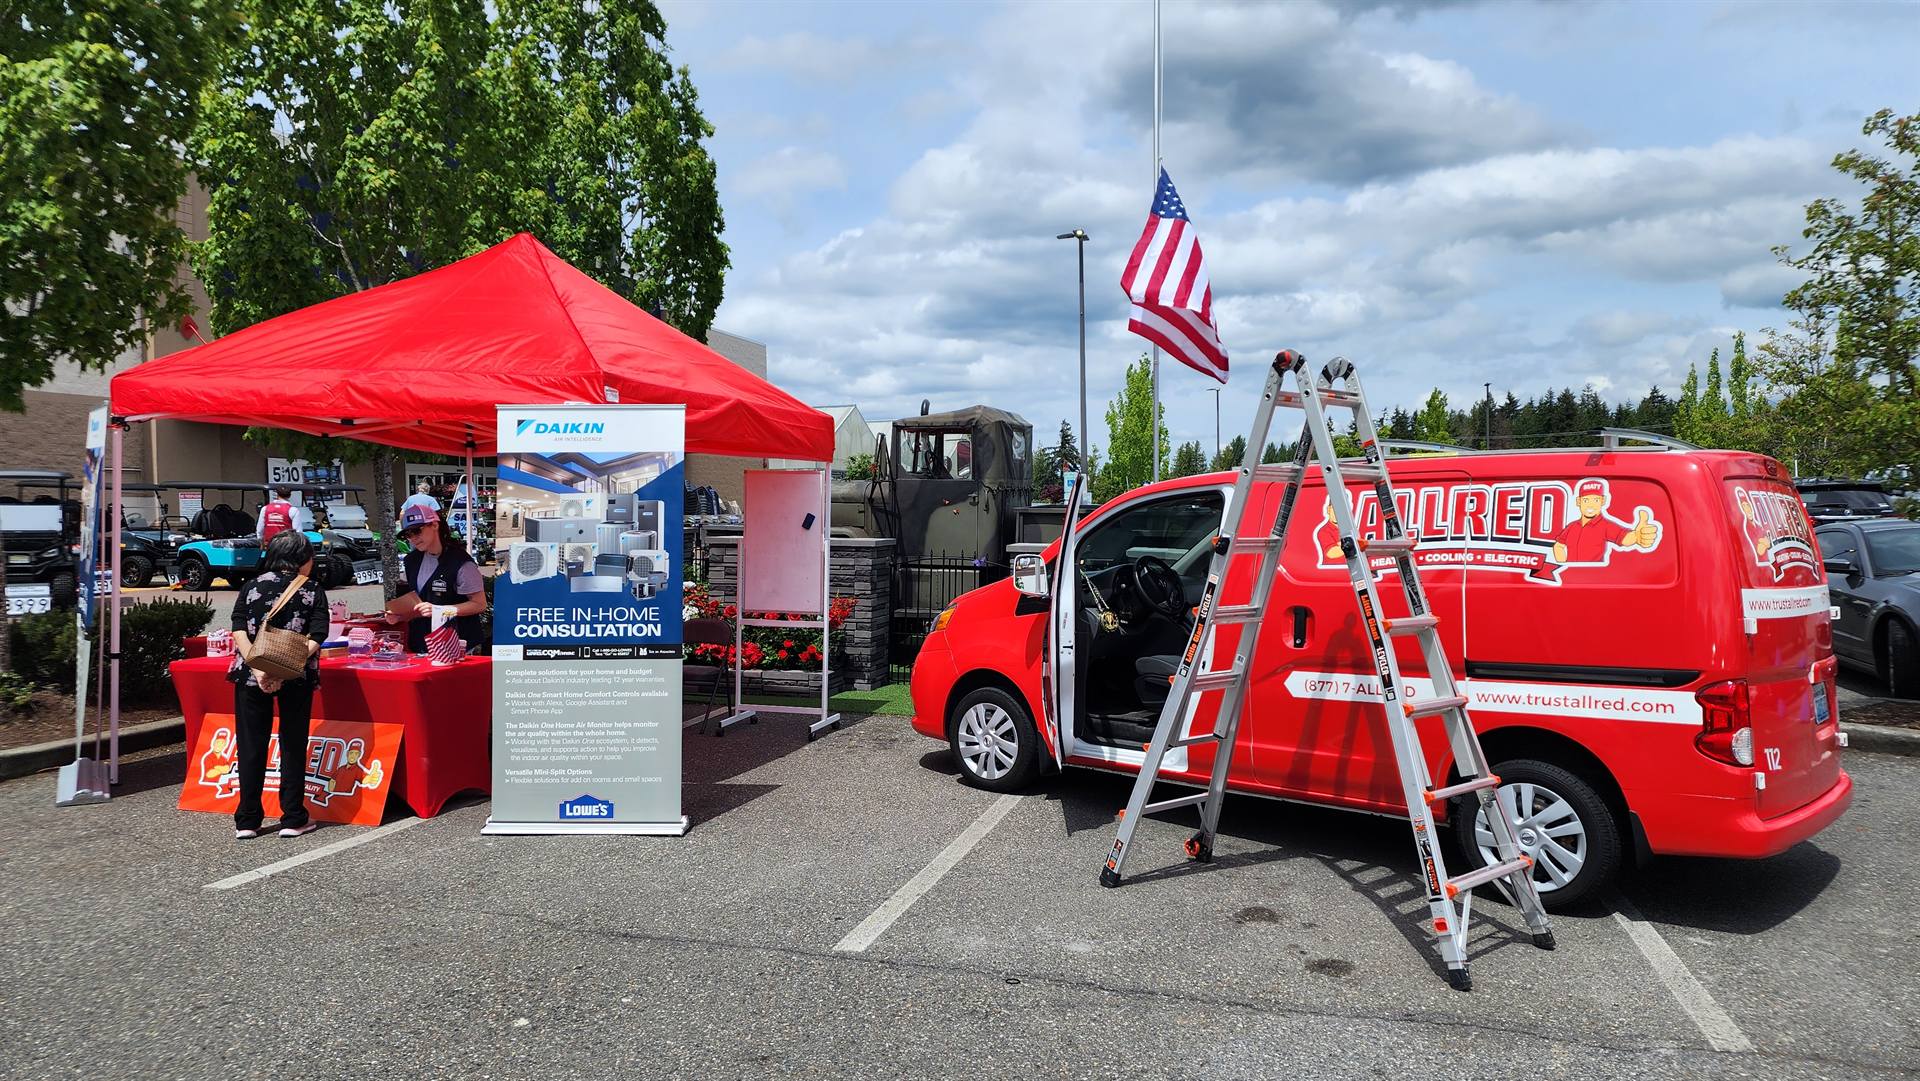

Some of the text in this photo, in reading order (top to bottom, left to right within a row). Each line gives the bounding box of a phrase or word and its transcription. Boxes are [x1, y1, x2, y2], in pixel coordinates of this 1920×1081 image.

[534, 422, 605, 434] DAIKIN
[1356, 484, 1568, 547] ALLRED
[1371, 553, 1539, 567] HEAT COOLING ELECTRIC
[517, 607, 660, 622] FREE IN-HOME
[1360, 594, 1372, 617] Little
[1368, 618, 1380, 641] Giant
[514, 623, 661, 638] CONSULTATION
[505, 670, 537, 678] Complete
[579, 670, 594, 678] your
[629, 668, 652, 676] budget
[1304, 680, 1416, 698] (877) 7-ALLD
[1476, 692, 1675, 714] www.trustallred.com
[527, 730, 549, 738] quality
[1764, 748, 1782, 771] 112
[567, 768, 593, 776] Options
[565, 803, 608, 816] LOWE'S
